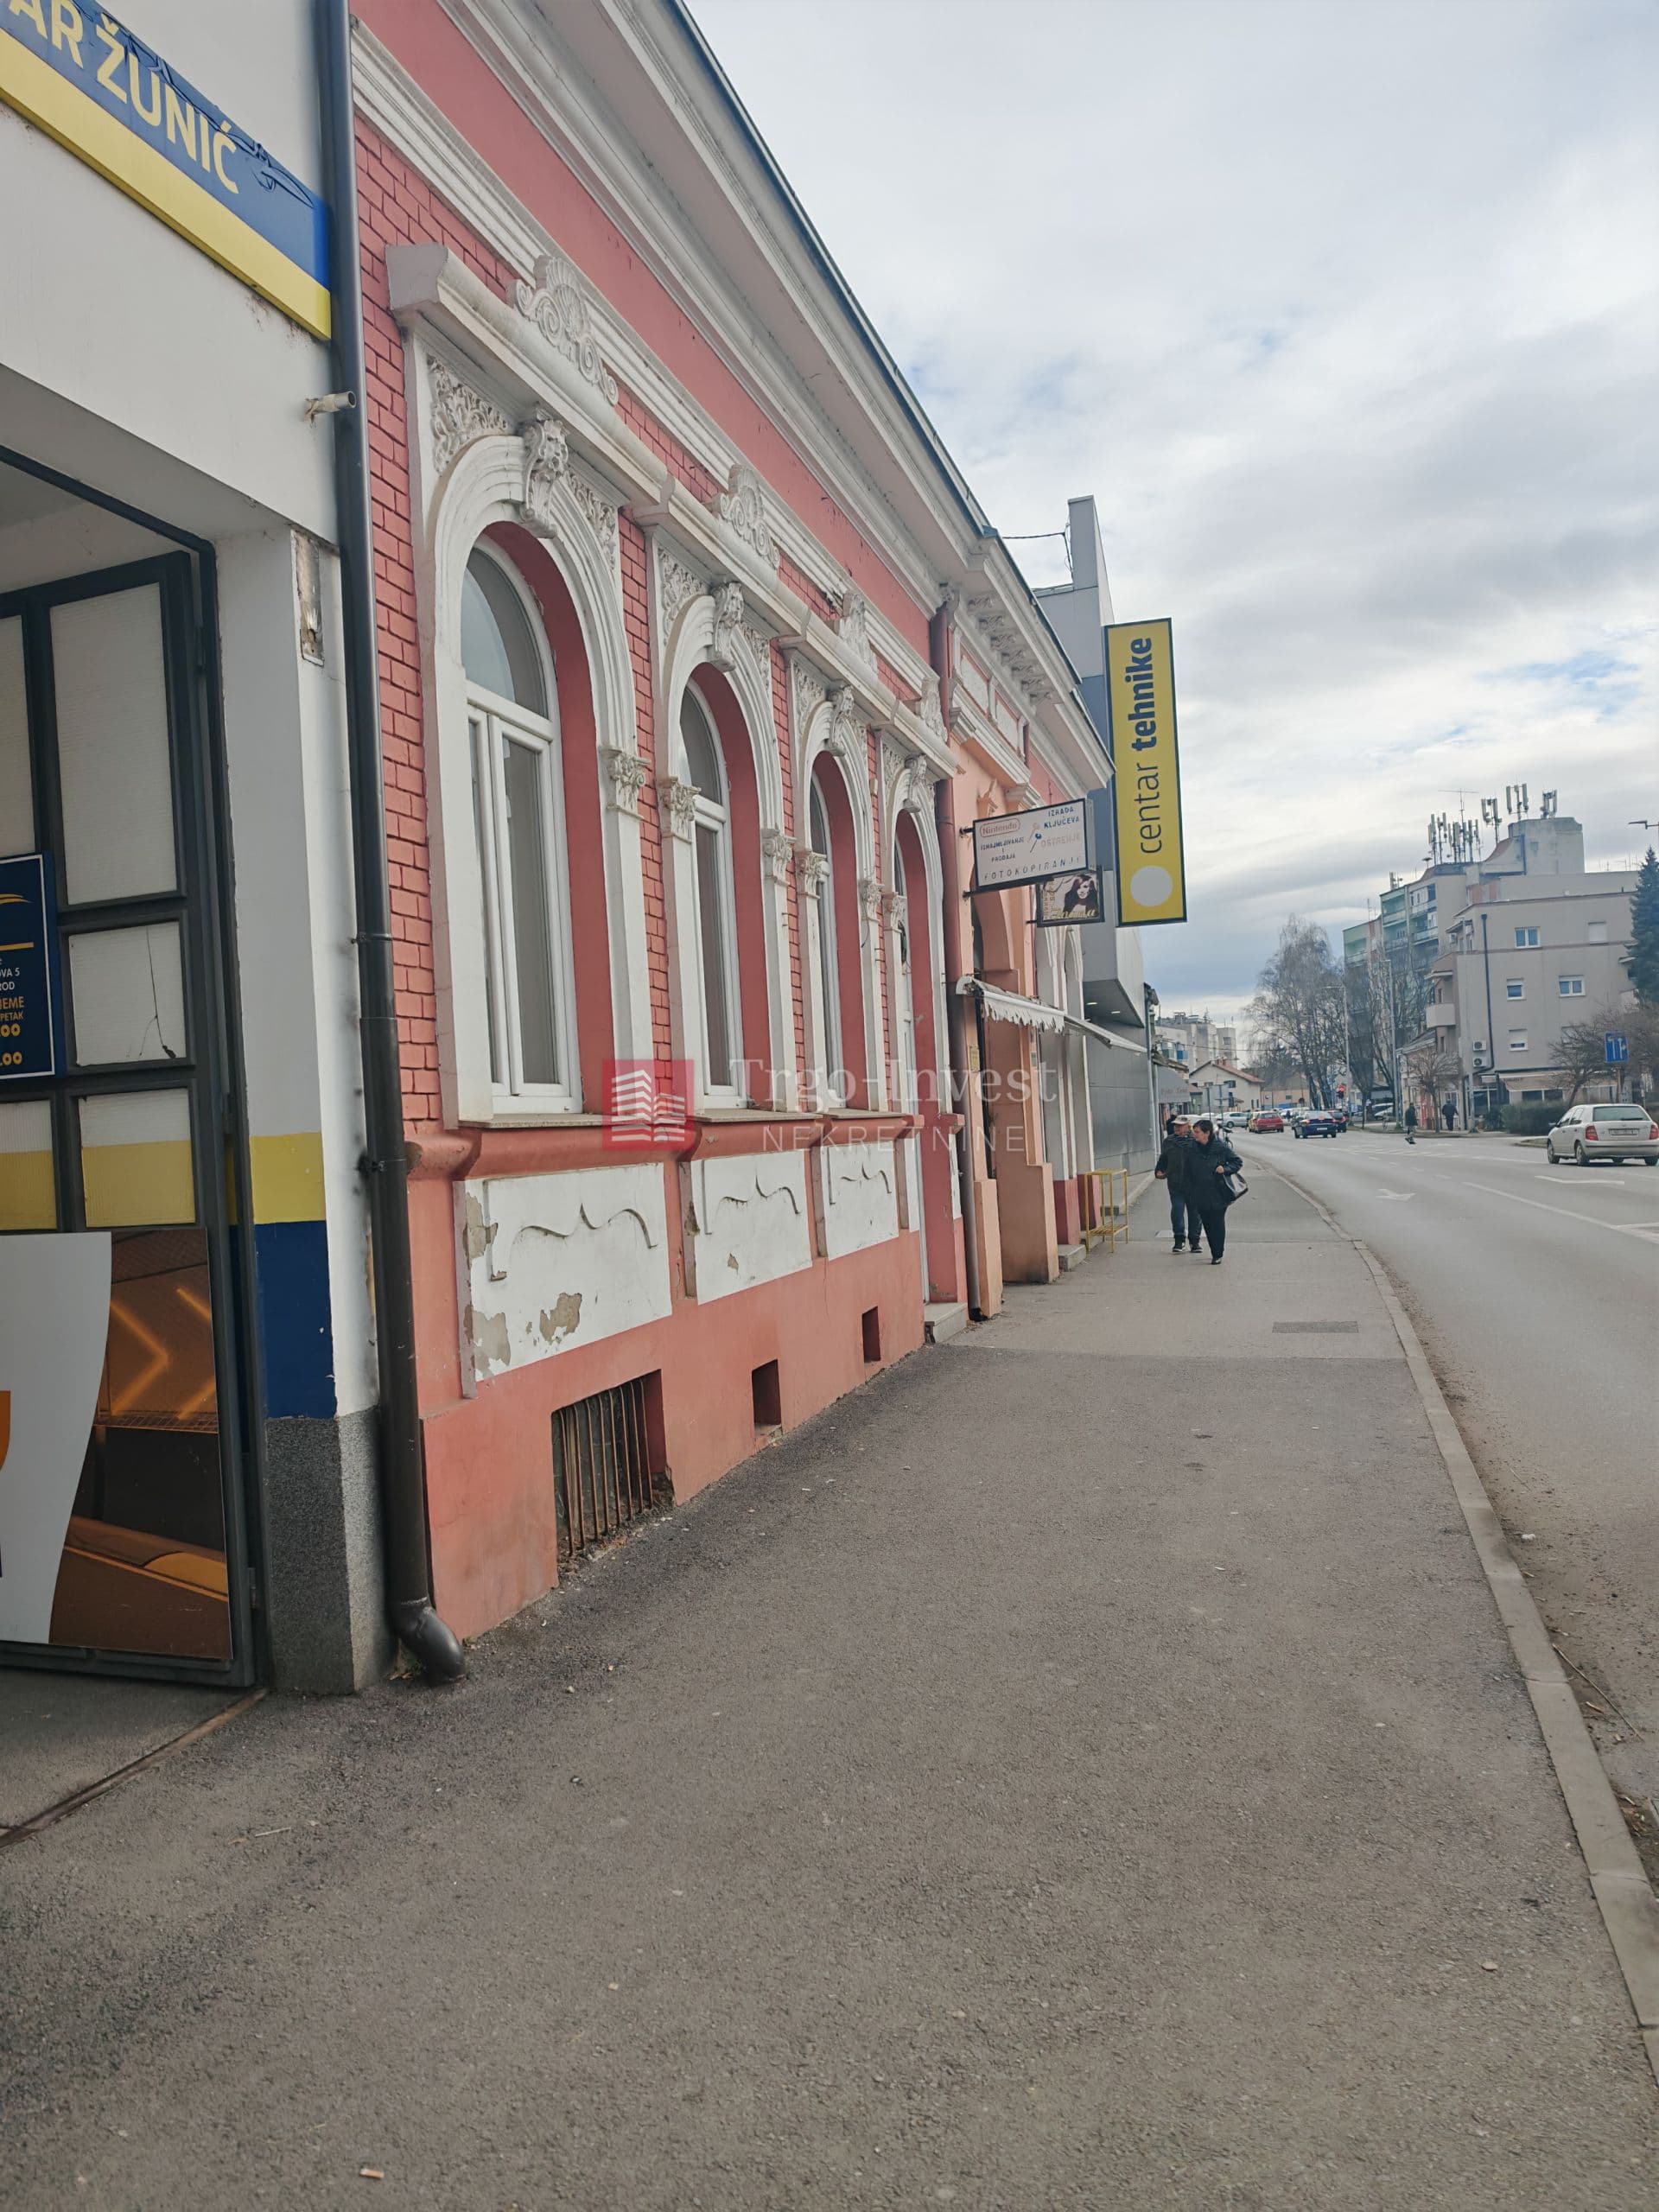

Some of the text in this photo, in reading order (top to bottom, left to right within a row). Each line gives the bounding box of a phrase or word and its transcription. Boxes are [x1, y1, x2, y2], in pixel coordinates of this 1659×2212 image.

[95, 12, 239, 194] ŽUNIĆ
[1125, 637, 1162, 855] centar tehnike
[1048, 806, 1074, 817] IZRADA
[982, 822, 1017, 835] Nintendo
[15, 967, 20, 976] 5
